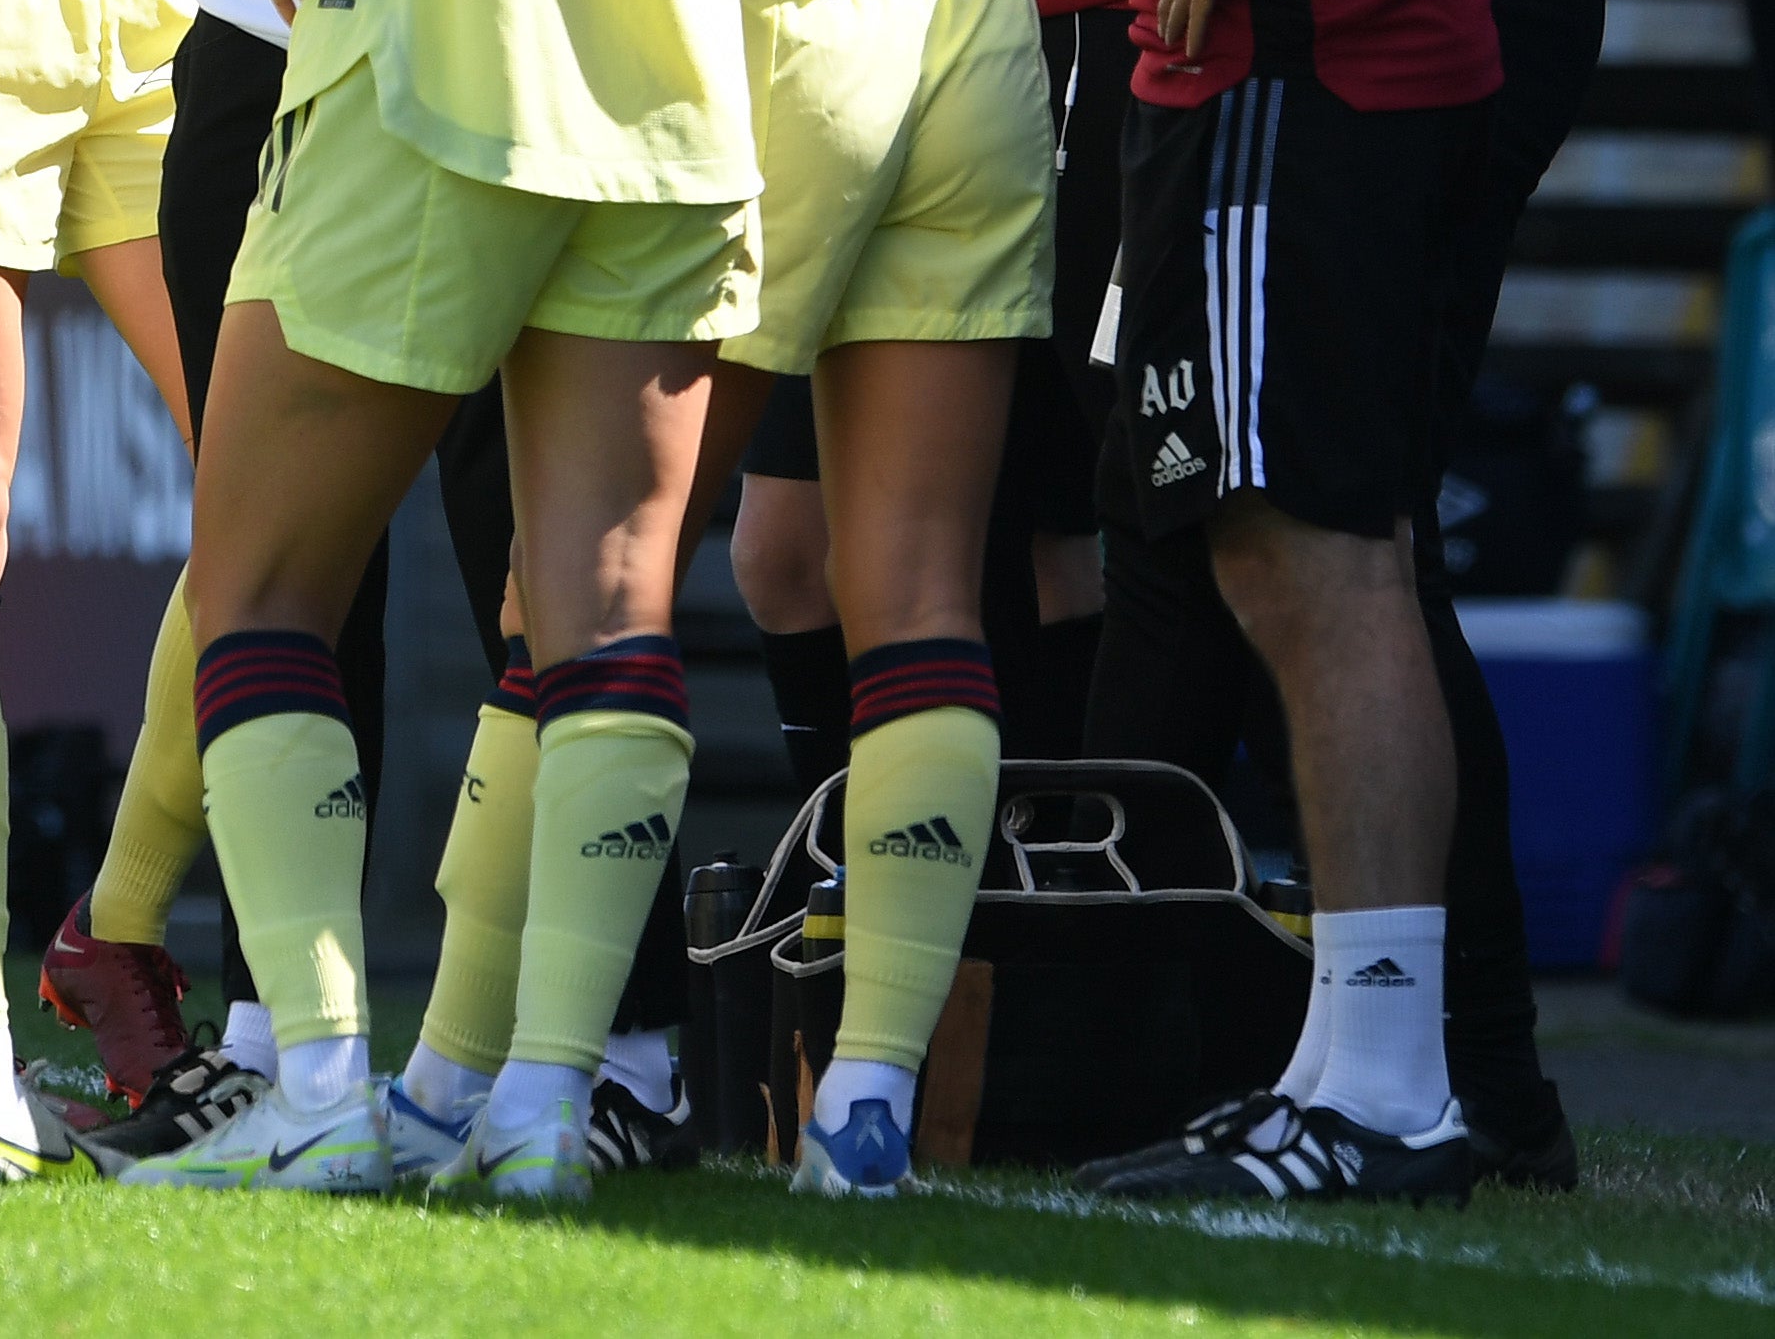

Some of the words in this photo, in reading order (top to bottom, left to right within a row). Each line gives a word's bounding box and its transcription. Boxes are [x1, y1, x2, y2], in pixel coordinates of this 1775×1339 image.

[1151, 457, 1207, 488] adidas
[581, 841, 667, 860] adida
[870, 840, 972, 868] adidas
[1345, 976, 1415, 988] adidas
